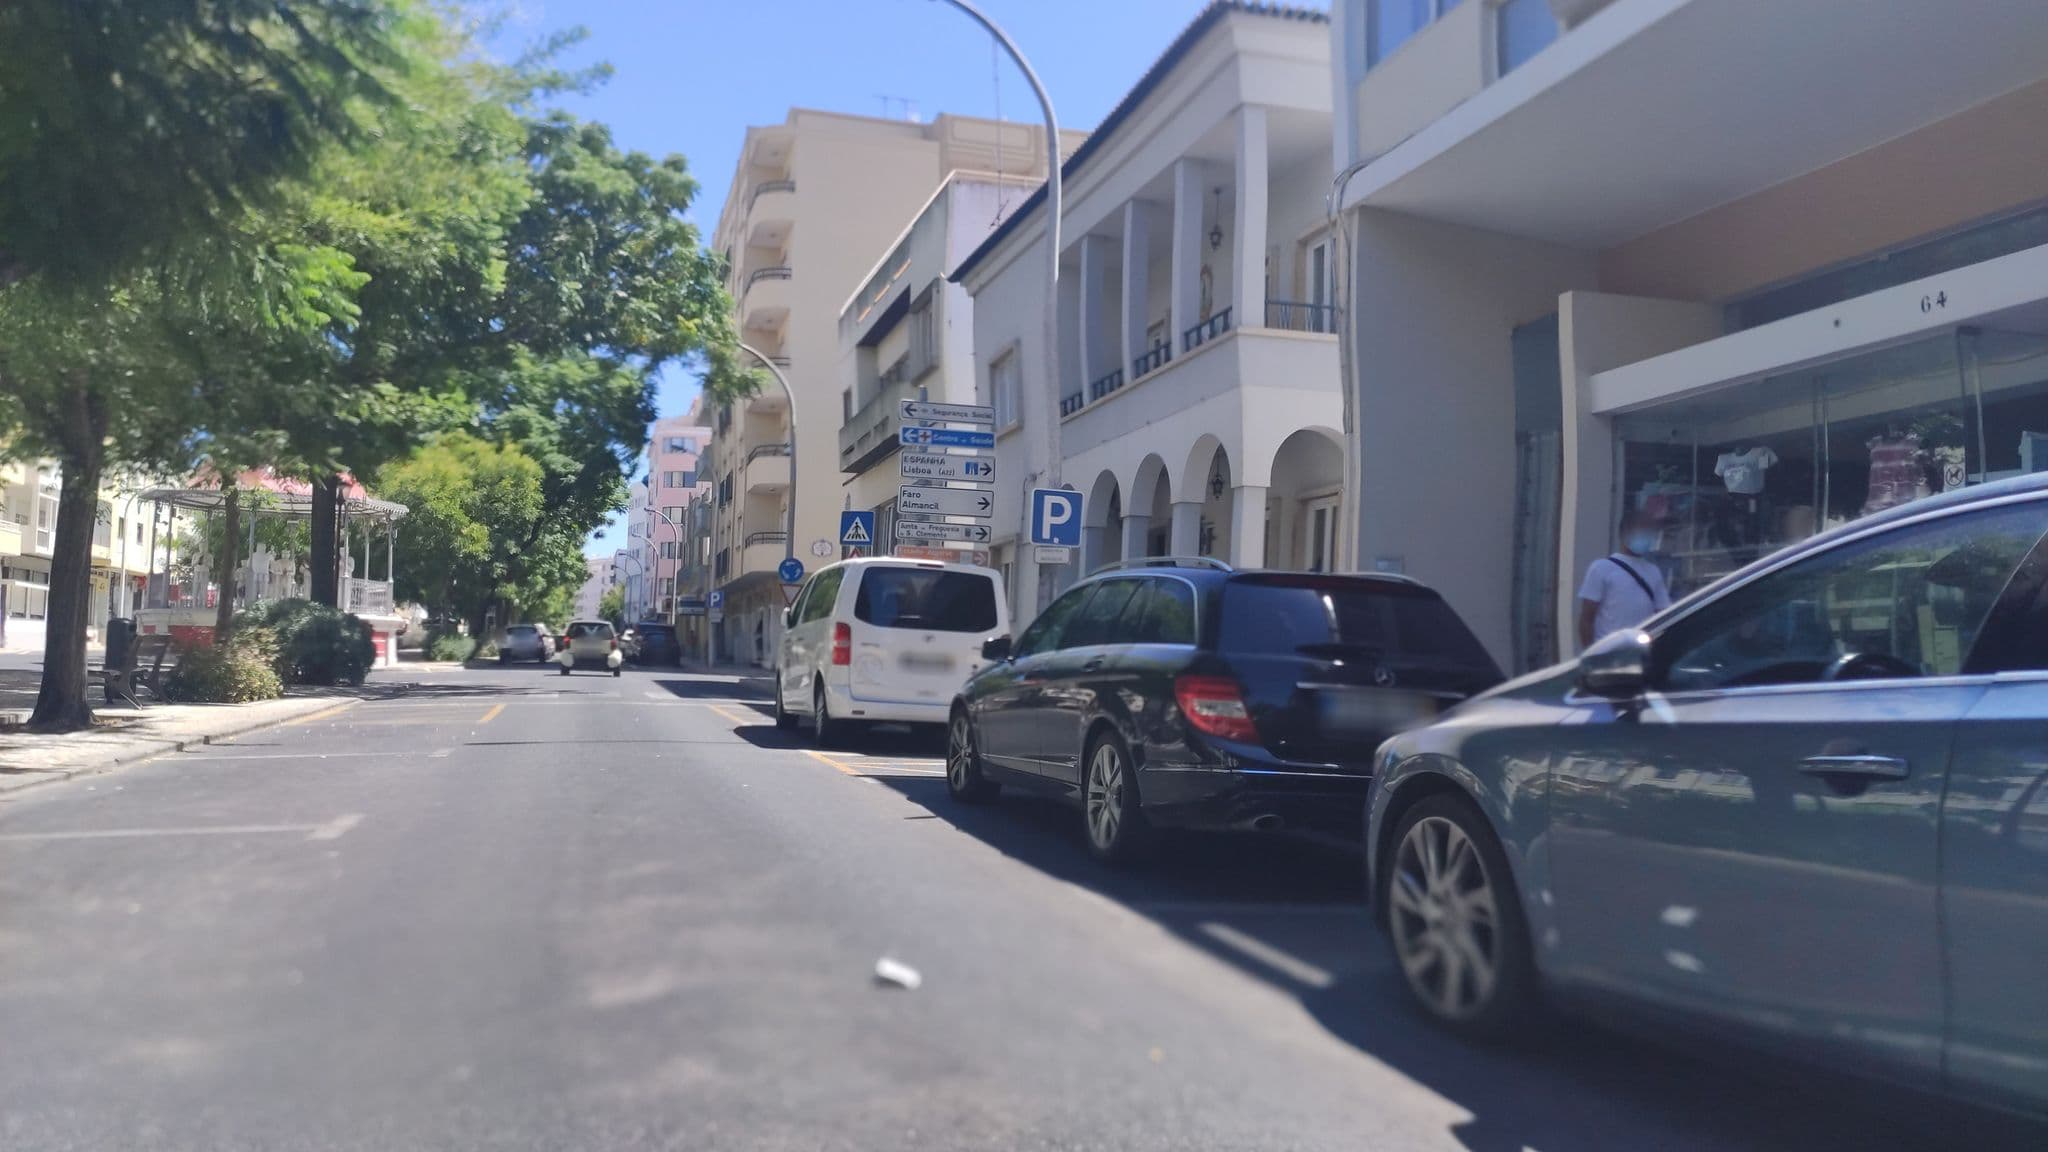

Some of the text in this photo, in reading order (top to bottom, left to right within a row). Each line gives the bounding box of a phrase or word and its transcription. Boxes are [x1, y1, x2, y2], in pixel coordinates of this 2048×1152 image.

[1920, 290, 1948, 313] 64
[903, 455, 946, 466] ESPANHA
[903, 465, 932, 475] Lisboa
[902, 490, 921, 499] Faro
[902, 500, 940, 511] Almancil
[1042, 495, 1072, 540] P
[915, 530, 947, 538] Clemente
[929, 524, 960, 533] Freguesia
[709, 592, 720, 607] P
